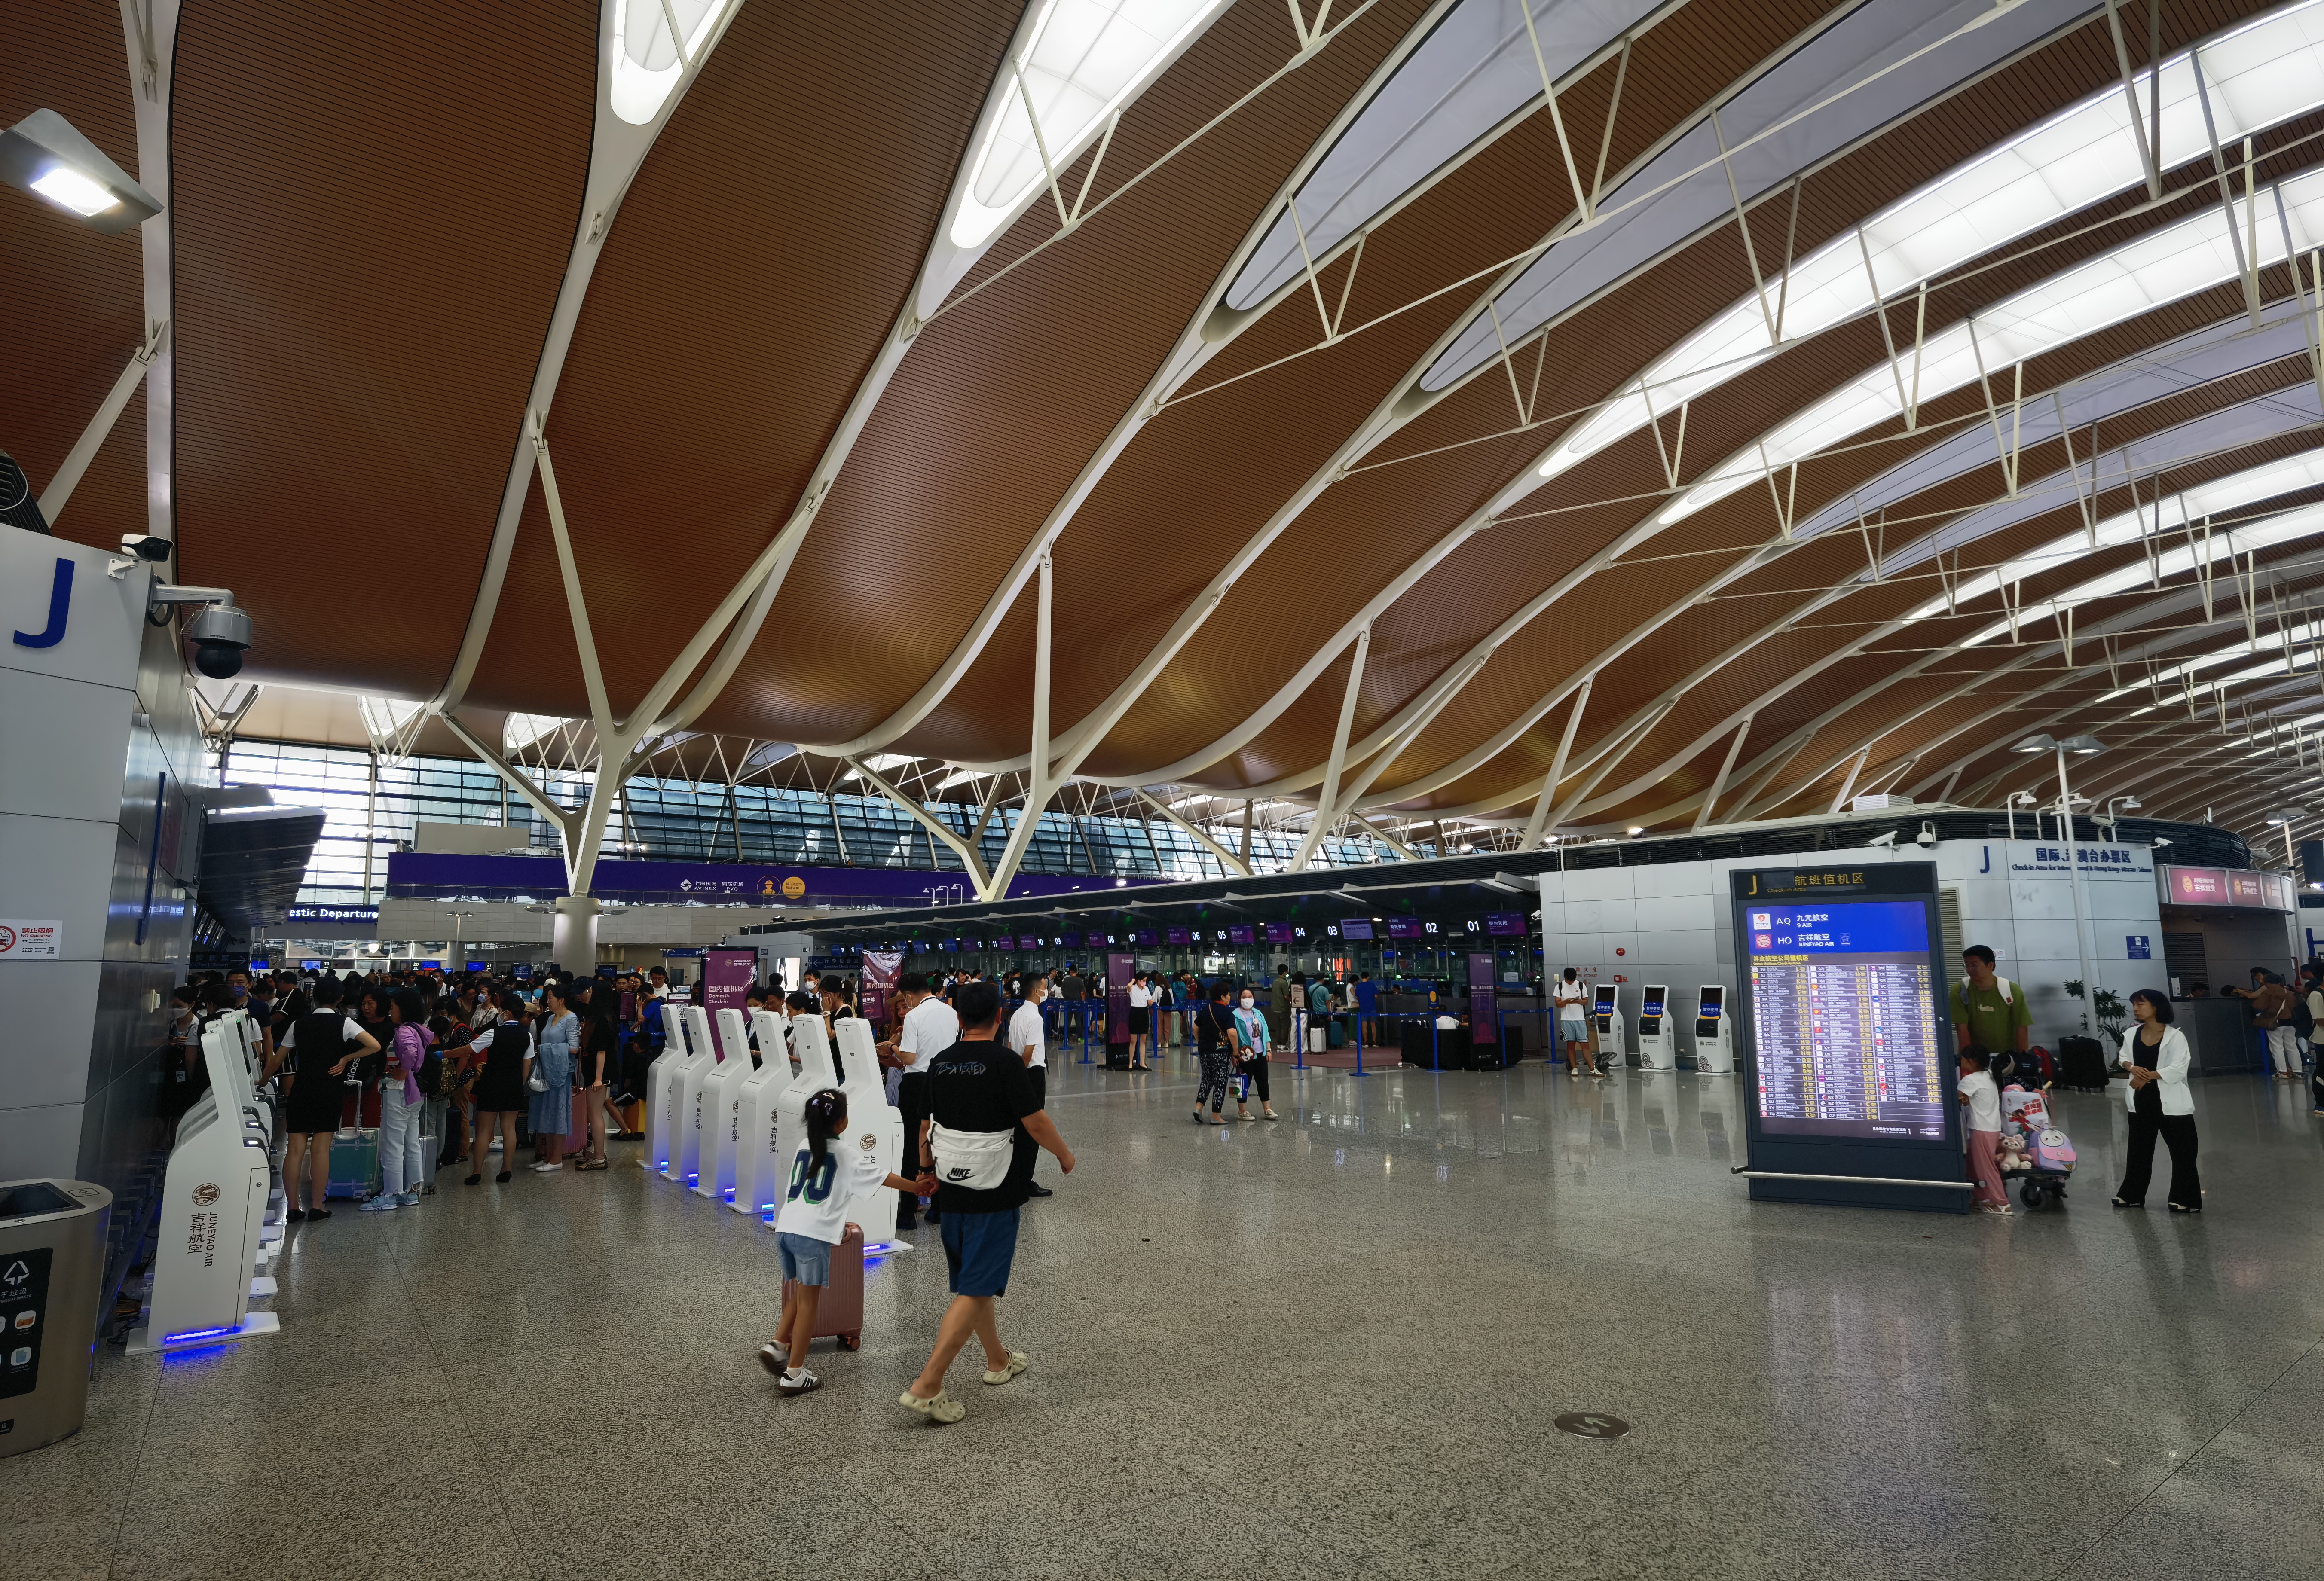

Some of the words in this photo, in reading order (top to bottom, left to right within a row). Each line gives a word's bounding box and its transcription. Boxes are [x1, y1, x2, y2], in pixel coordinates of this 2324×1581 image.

[13, 558, 75, 648] J
[1980, 846, 1990, 873] J
[1795, 873, 1864, 886] 航班值机区
[1749, 875, 1757, 895] J
[320, 909, 379, 919] Departure
[1468, 921, 1479, 931] 01
[1777, 917, 1791, 925] AQ
[1295, 928, 1305, 937] 04
[1327, 926, 1338, 935] 03
[1426, 922, 1438, 933] 02
[1107, 935, 1115, 943] 08
[1129, 934, 1135, 942] 07
[1192, 932, 1200, 940] 06
[1218, 931, 1226, 940] 05
[950, 1167, 971, 1178] NIKE
[187, 1212, 207, 1254] 吉祥航空
[206, 1212, 217, 1251] JUNEYAO
[204, 1253, 214, 1267] AIR
